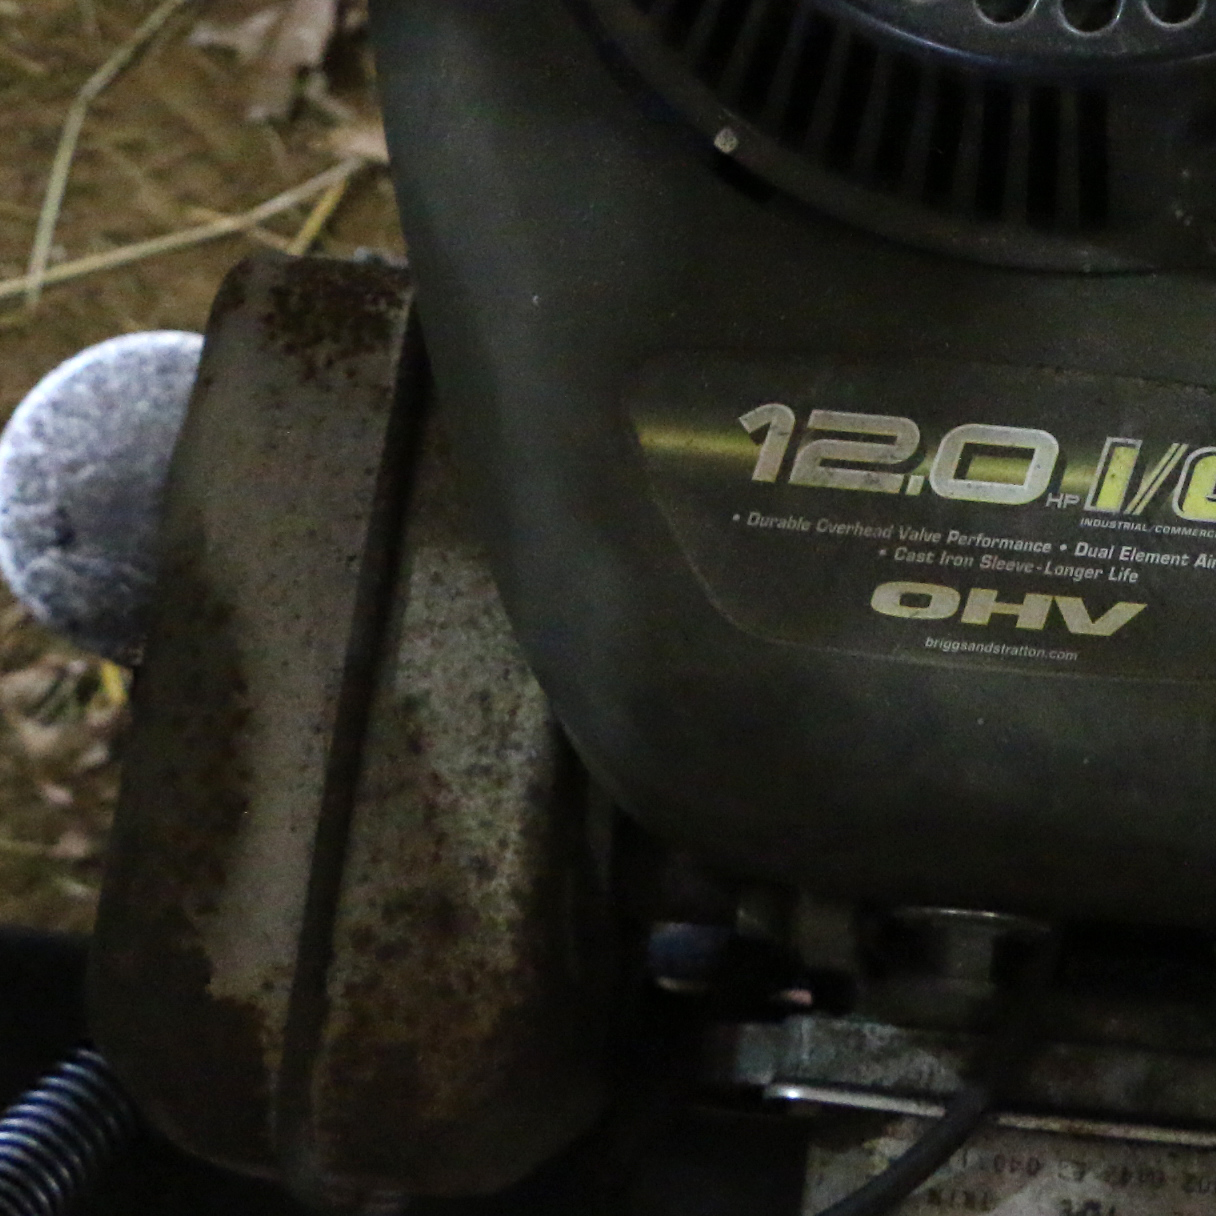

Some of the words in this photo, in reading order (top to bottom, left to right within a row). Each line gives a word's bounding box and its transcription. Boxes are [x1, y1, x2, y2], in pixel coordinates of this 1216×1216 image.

[738, 402, 1060, 505] 12.0
[1045, 492, 1081, 510] HP
[746, 511, 811, 532] Durable
[815, 517, 894, 540] Overhead
[898, 525, 942, 544] Valve
[946, 529, 1053, 555] Performance
[1073, 541, 1116, 560] Dual
[1118, 545, 1191, 567] Element
[893, 546, 935, 565] Cast
[939, 550, 975, 569] Iron
[1107, 566, 1140, 584] Life
[870, 580, 1149, 637] OHV
[923, 635, 1080, 662] briggsandstratton.com
